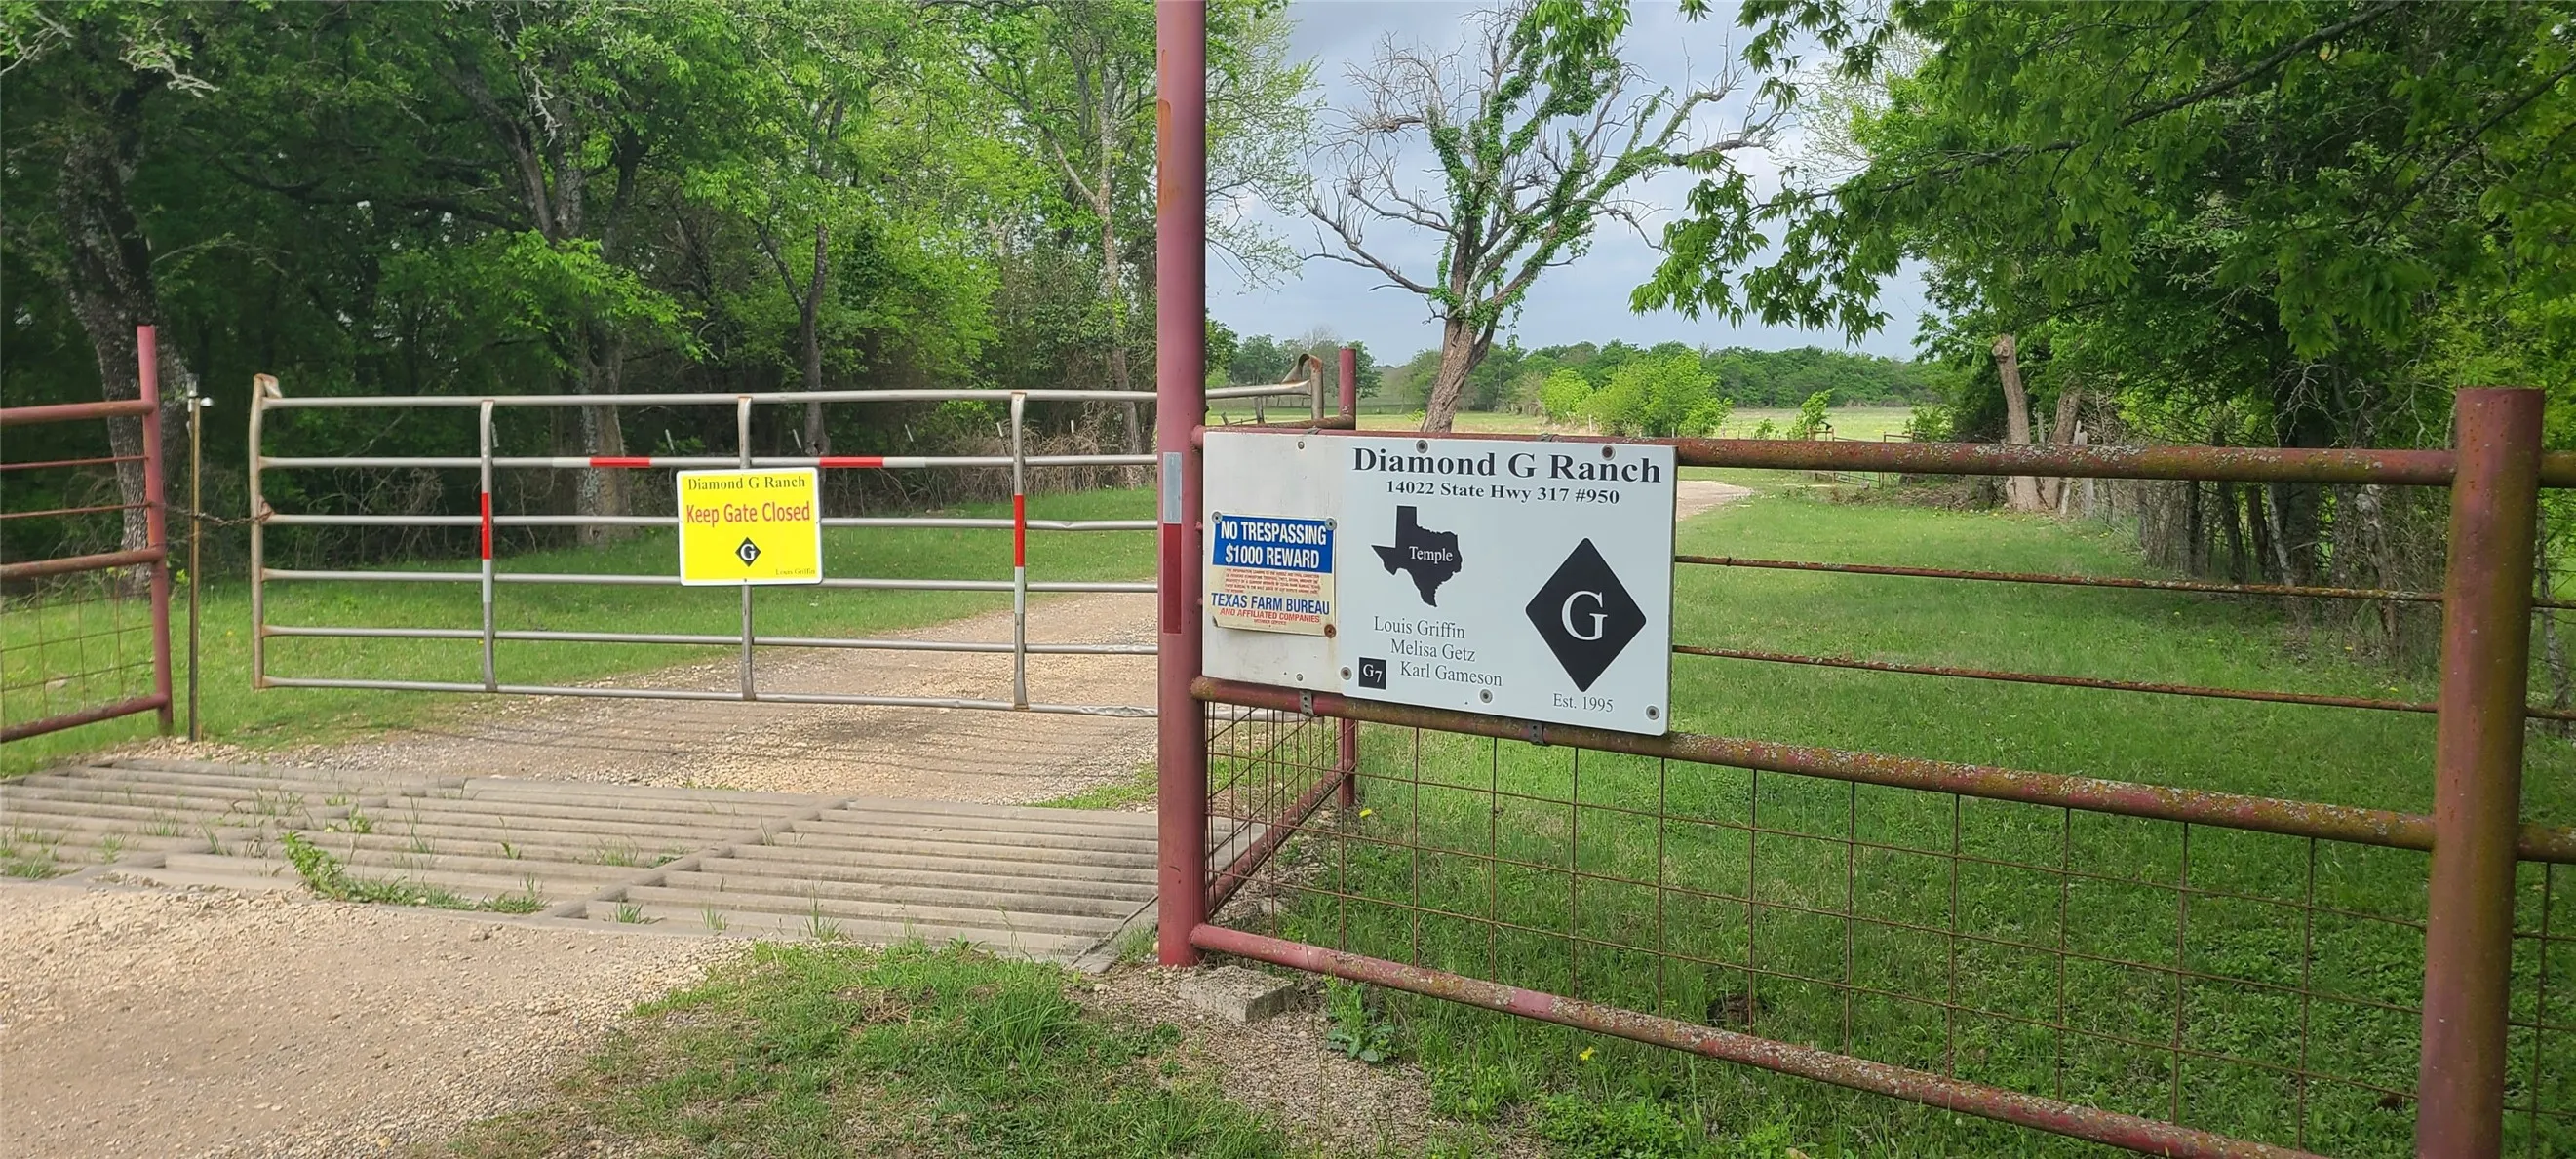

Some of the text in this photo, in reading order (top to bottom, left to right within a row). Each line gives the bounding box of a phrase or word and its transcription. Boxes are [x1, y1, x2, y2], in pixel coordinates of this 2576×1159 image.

[1353, 447, 1660, 483] Diamond G Ranch
[688, 476, 805, 490] Diamond G Ranch
[1386, 480, 1620, 505] 14022 State Hwy 317 #950
[686, 501, 810, 527] Keep Gate Closed
[1221, 521, 1326, 545] NO TRESPASSING
[740, 544, 756, 560] G
[1226, 543, 1319, 568] $1000 REWARD
[1409, 546, 1453, 563] Temple
[1211, 593, 1329, 614] TEXAS FARM BUREAU
[1561, 590, 1608, 640] G
[1237, 610, 1277, 619] AFFILIATED
[1280, 613, 1320, 623] COMPANIES
[1374, 616, 1465, 639] Louis Griffin
[1390, 638, 1475, 662] Melisa Getz
[1399, 661, 1503, 687] Karl Gameson
[1553, 693, 1614, 713] Est. 1995
